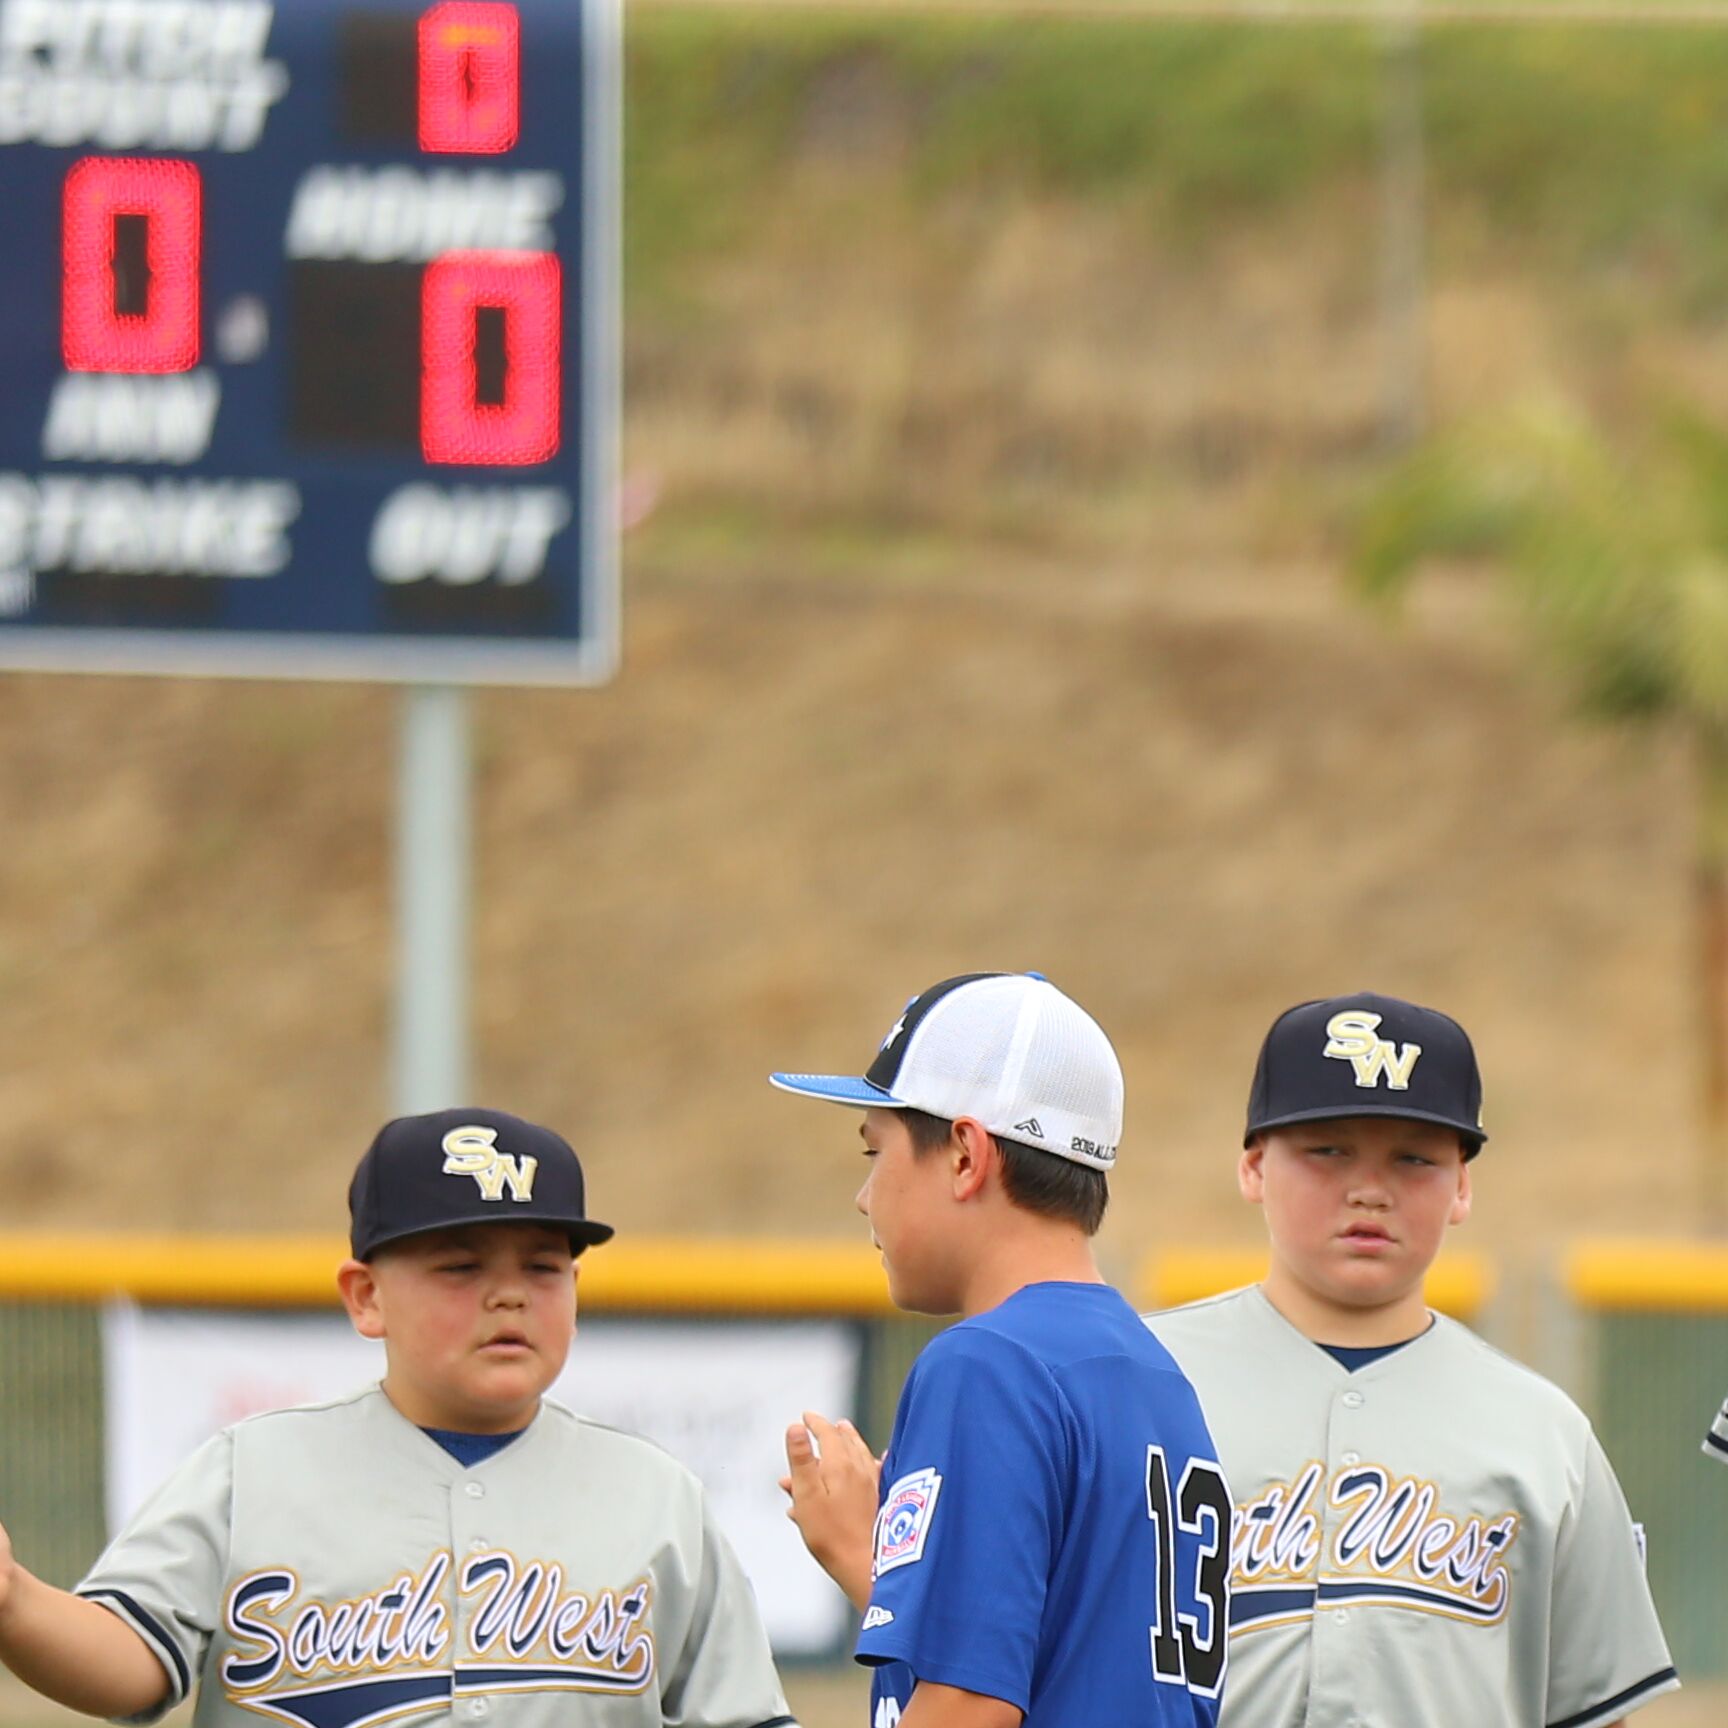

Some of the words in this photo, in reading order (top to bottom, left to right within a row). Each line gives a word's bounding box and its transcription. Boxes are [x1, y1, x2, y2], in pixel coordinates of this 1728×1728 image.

[0, 62, 289, 151] COUNT
[417, 0, 520, 154] 0
[63, 156, 202, 374] 0
[286, 166, 564, 262] HOME
[42, 368, 220, 462] INN
[420, 249, 562, 466] 0
[368, 484, 572, 584] OUT
[1322, 1010, 1421, 1090] SW
[442, 1125, 538, 1202] SW
[1145, 1444, 1236, 1699] 13
[1328, 1464, 1514, 1600] West
[218, 1546, 456, 1696] South
[457, 1548, 657, 1674] West
